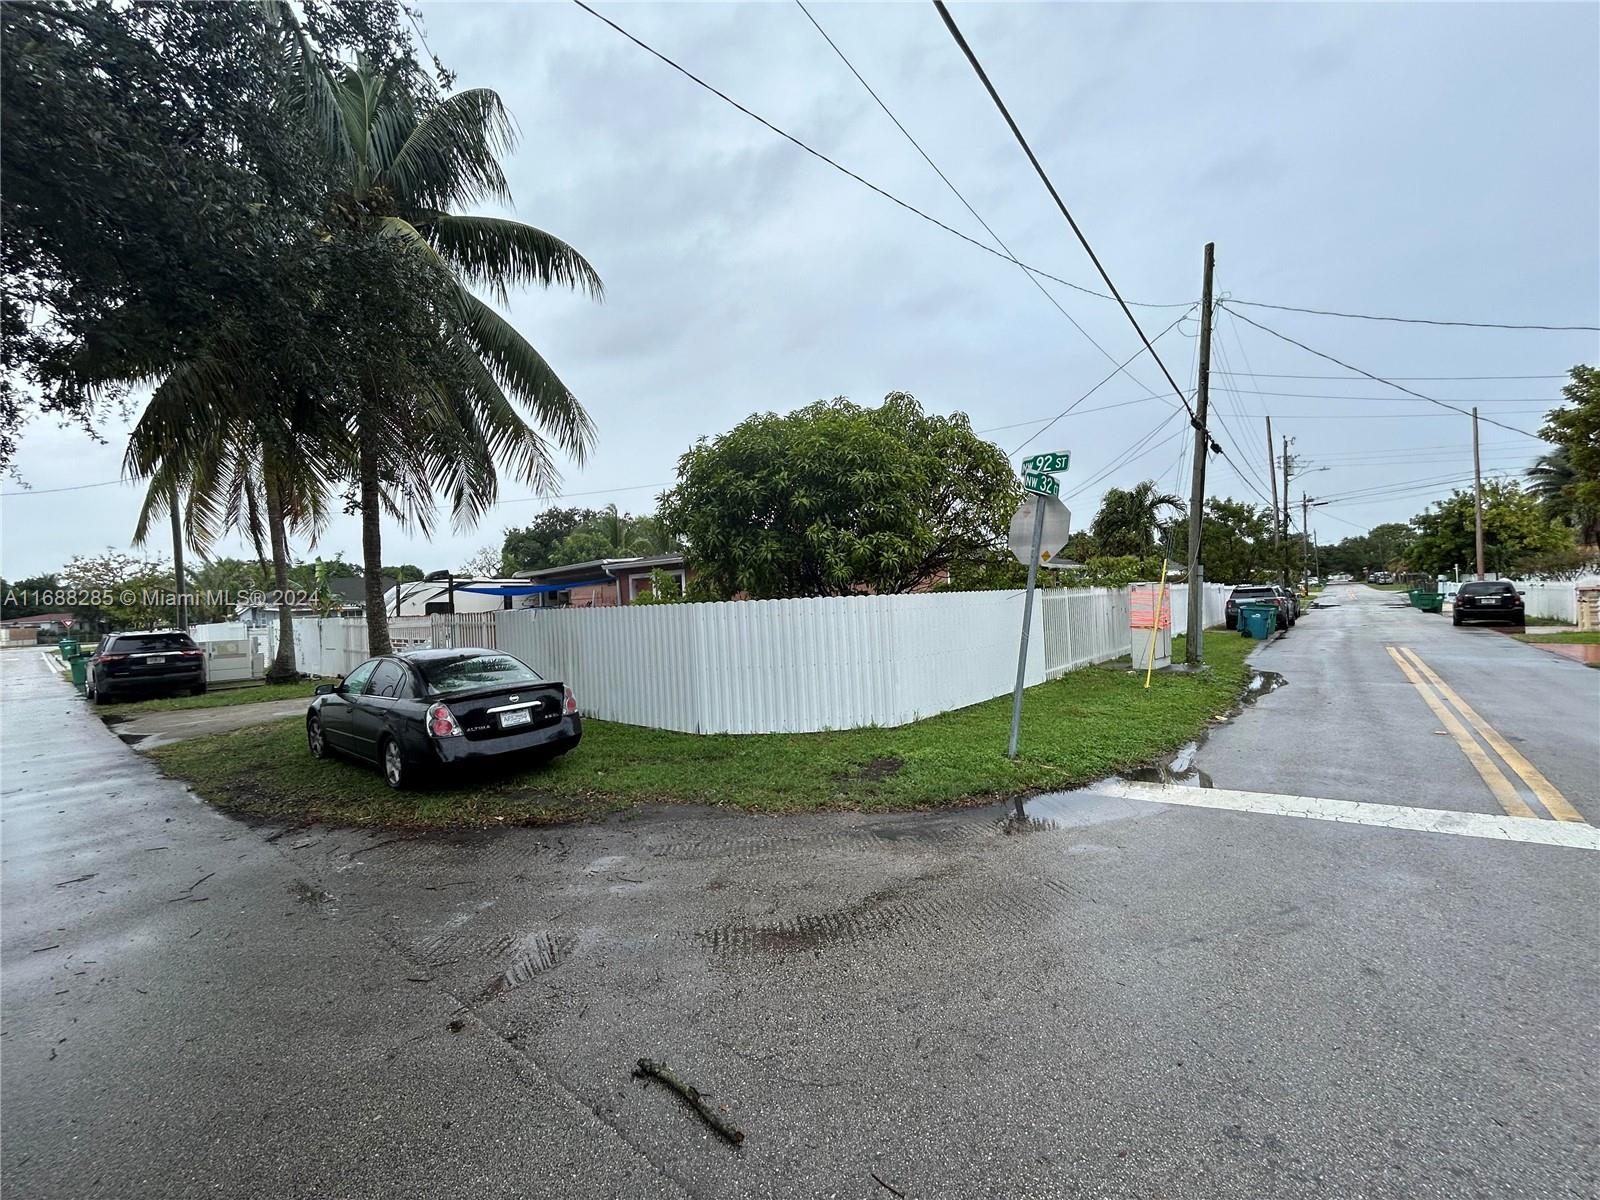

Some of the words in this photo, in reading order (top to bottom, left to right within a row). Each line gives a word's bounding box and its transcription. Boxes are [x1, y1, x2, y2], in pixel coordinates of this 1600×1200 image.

[1036, 455, 1053, 471] 92
[1055, 457, 1067, 468] ST
[1025, 475, 1038, 488] NW
[1040, 475, 1053, 494] 32
